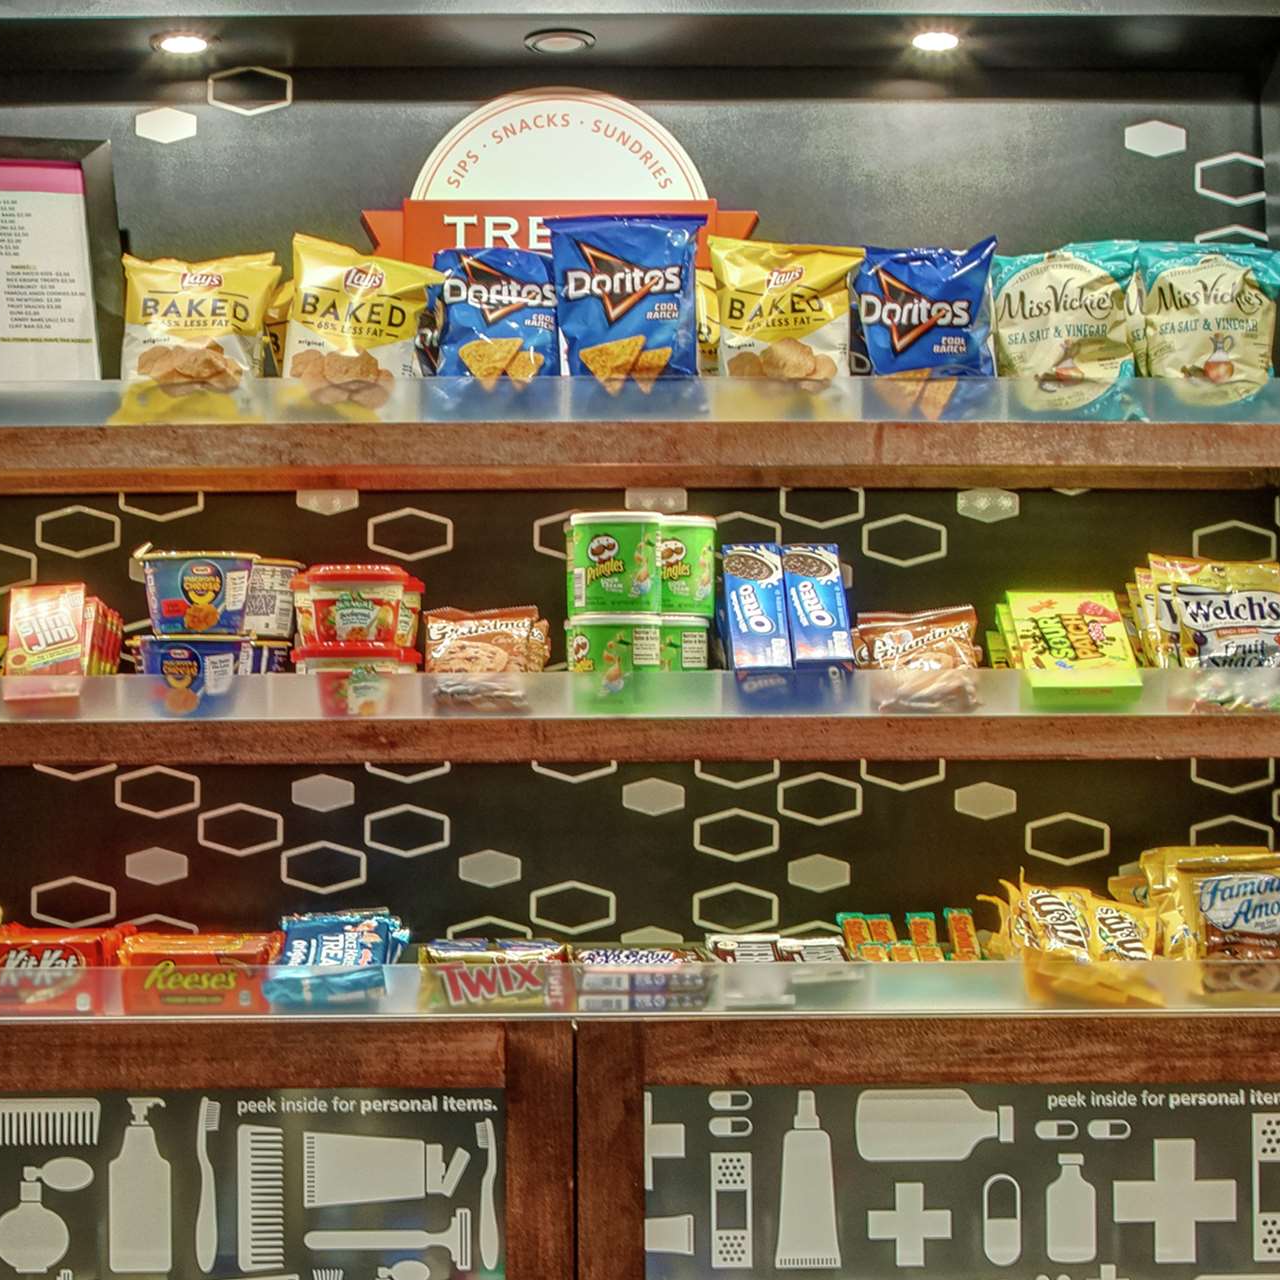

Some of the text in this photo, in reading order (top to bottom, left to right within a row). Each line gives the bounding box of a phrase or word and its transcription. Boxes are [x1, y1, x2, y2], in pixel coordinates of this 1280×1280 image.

[446, 113, 673, 190] SIPS SNACKS SUNDRIES
[443, 277, 557, 308] Doritos
[567, 266, 682, 299] Doritos
[141, 296, 250, 323] BAKED
[300, 292, 407, 329] BAKED
[646, 310, 679, 320] RANCH
[654, 302, 678, 312] COOL
[860, 294, 970, 327] Doritos
[184, 319, 209, 328] LESS
[211, 318, 230, 328] FAT
[341, 326, 363, 337] LSS
[365, 327, 384, 338] FAT
[766, 317, 790, 328] LESS
[793, 315, 811, 326] FAT
[1159, 322, 1176, 336] SEA
[1177, 319, 1200, 333] SALT
[1216, 317, 1258, 333] VINEGAR
[941, 336, 966, 346] COOL
[1007, 323, 1108, 346] SEA SALT & VINEGAR
[933, 344, 967, 354] RANCH
[585, 558, 626, 587] Pringles
[660, 562, 691, 582] ingles
[738, 584, 776, 635] OREO
[797, 580, 836, 628] OREO
[1037, 615, 1076, 661] SOUR
[1059, 613, 1105, 661] PATCH
[1224, 639, 1267, 658] Fruit
[437, 960, 542, 1004] Twix
[237, 1095, 498, 1116] peek inside for personal items.
[1047, 1091, 1086, 1111] peek
[1090, 1090, 1137, 1108] inside
[1140, 1089, 1167, 1107] for
[1169, 1088, 1245, 1110] personal
